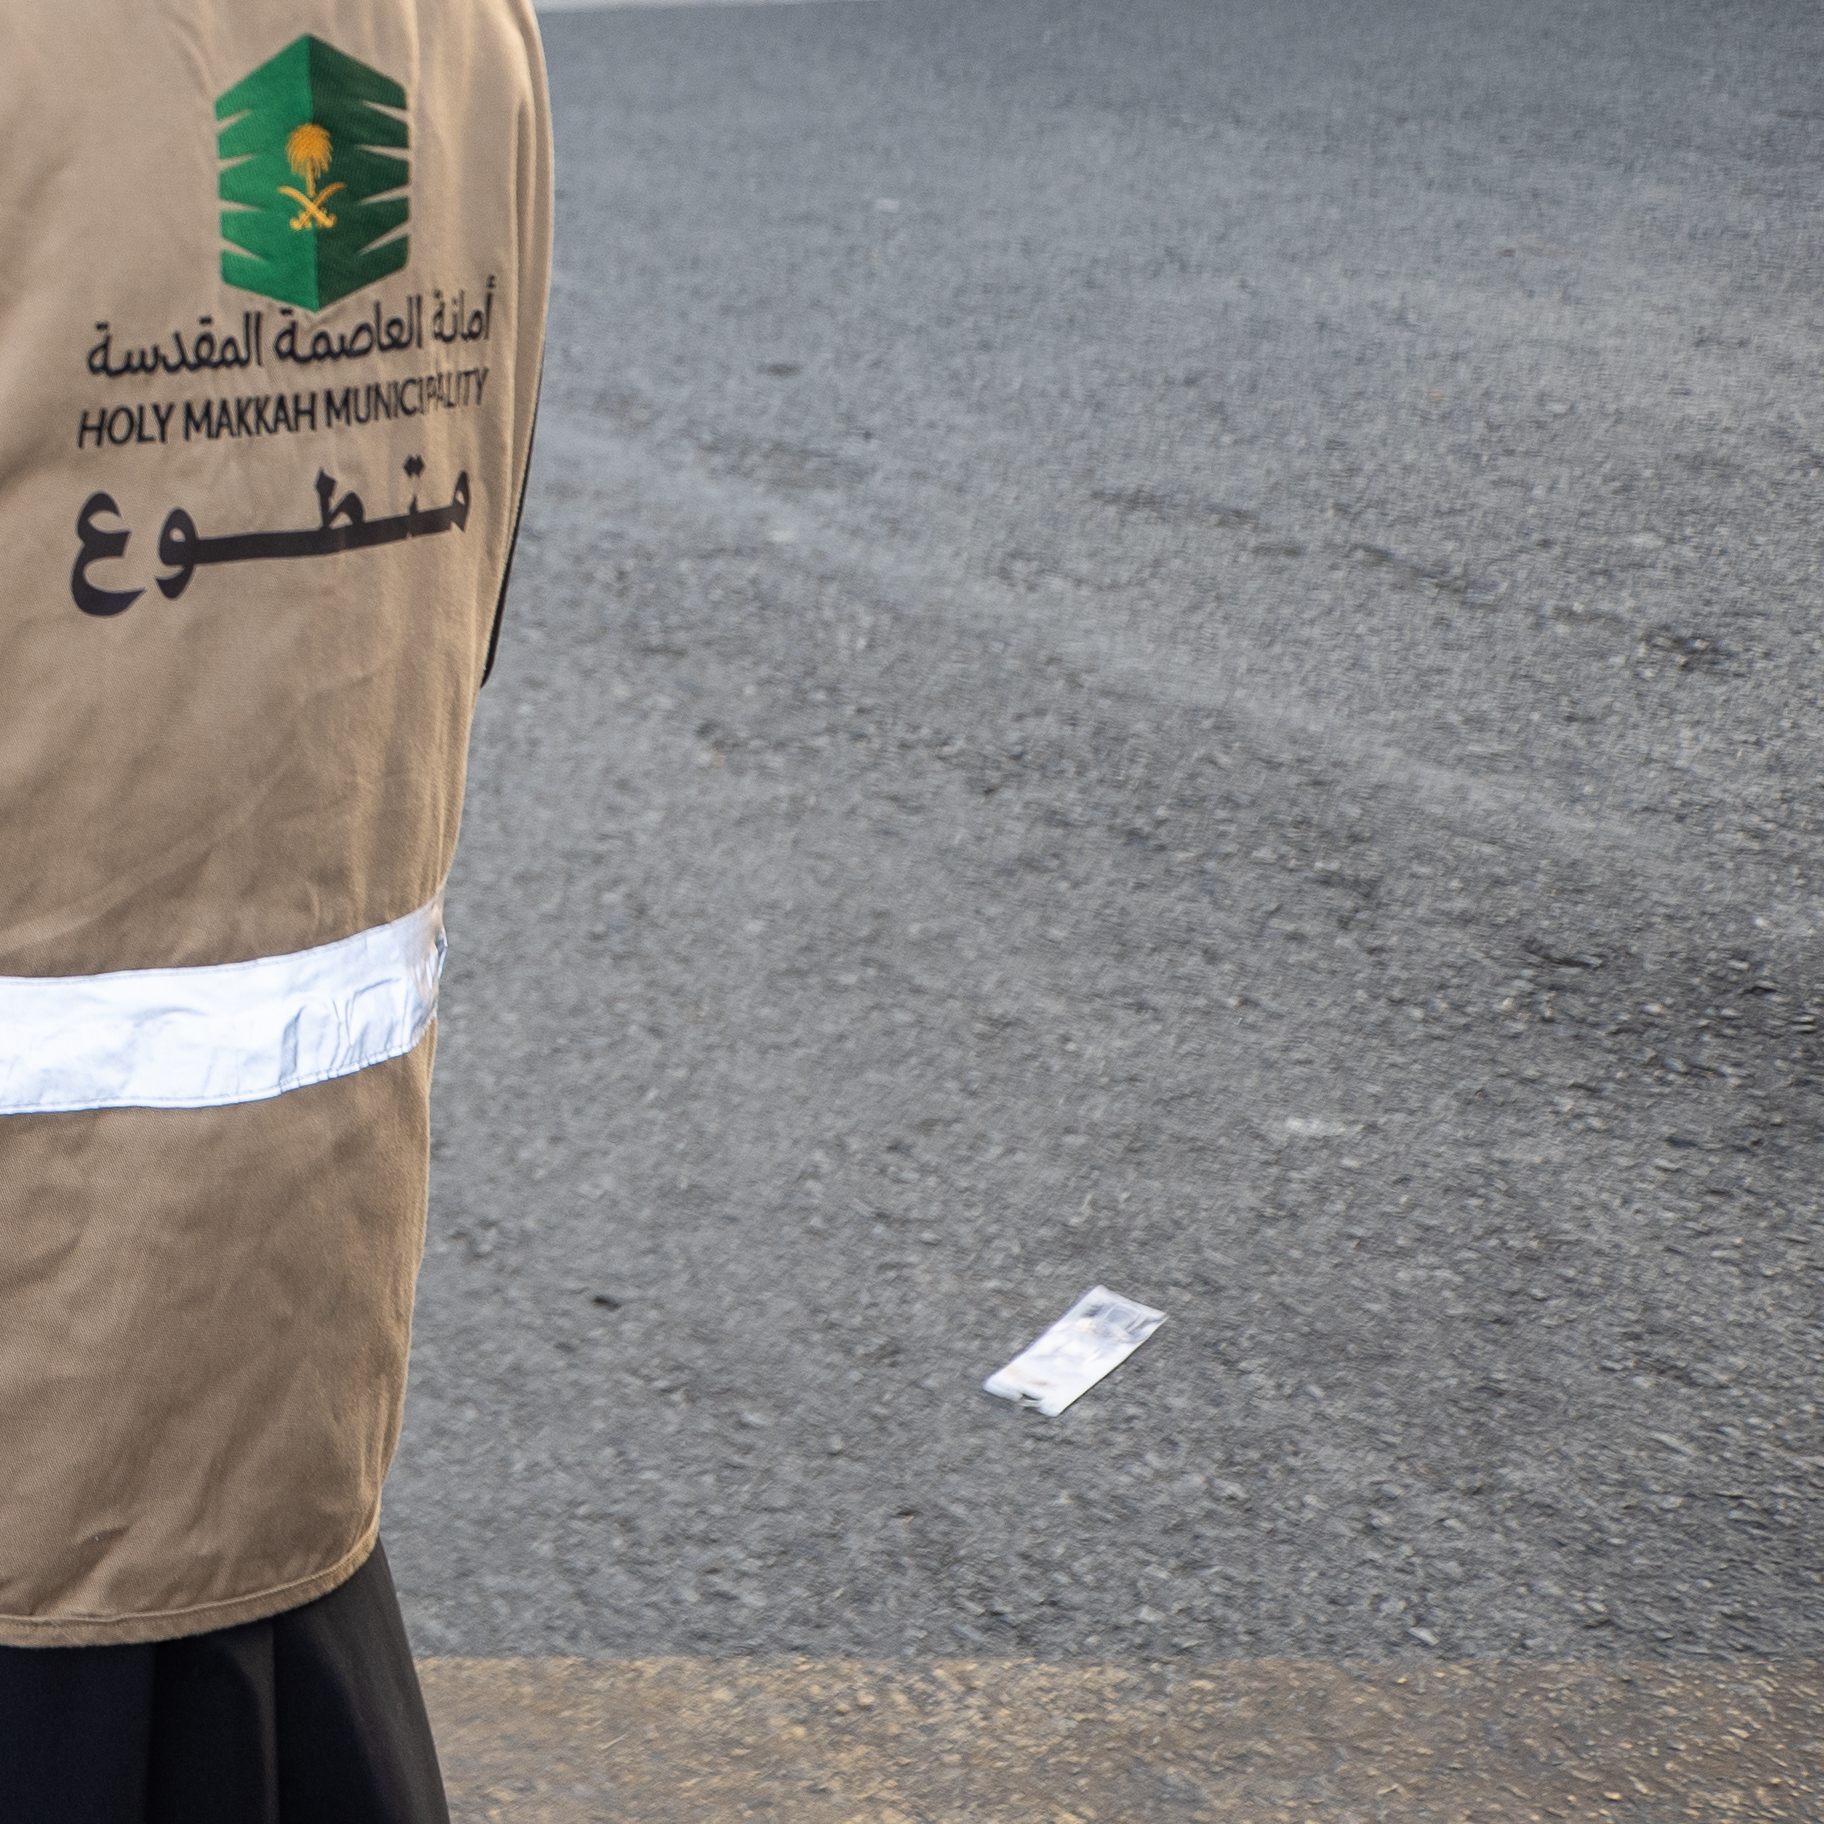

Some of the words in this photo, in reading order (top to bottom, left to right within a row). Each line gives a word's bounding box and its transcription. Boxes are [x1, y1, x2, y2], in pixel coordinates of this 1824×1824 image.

[87, 310, 262, 378] المقدسة
[273, 293, 422, 364] العاصمة
[432, 274, 495, 343] أمانة
[77, 402, 175, 449] HOLY
[184, 388, 317, 442] MAKKAH
[324, 367, 490, 428] MUNICIPALITY
[71, 455, 471, 618] متطوع
